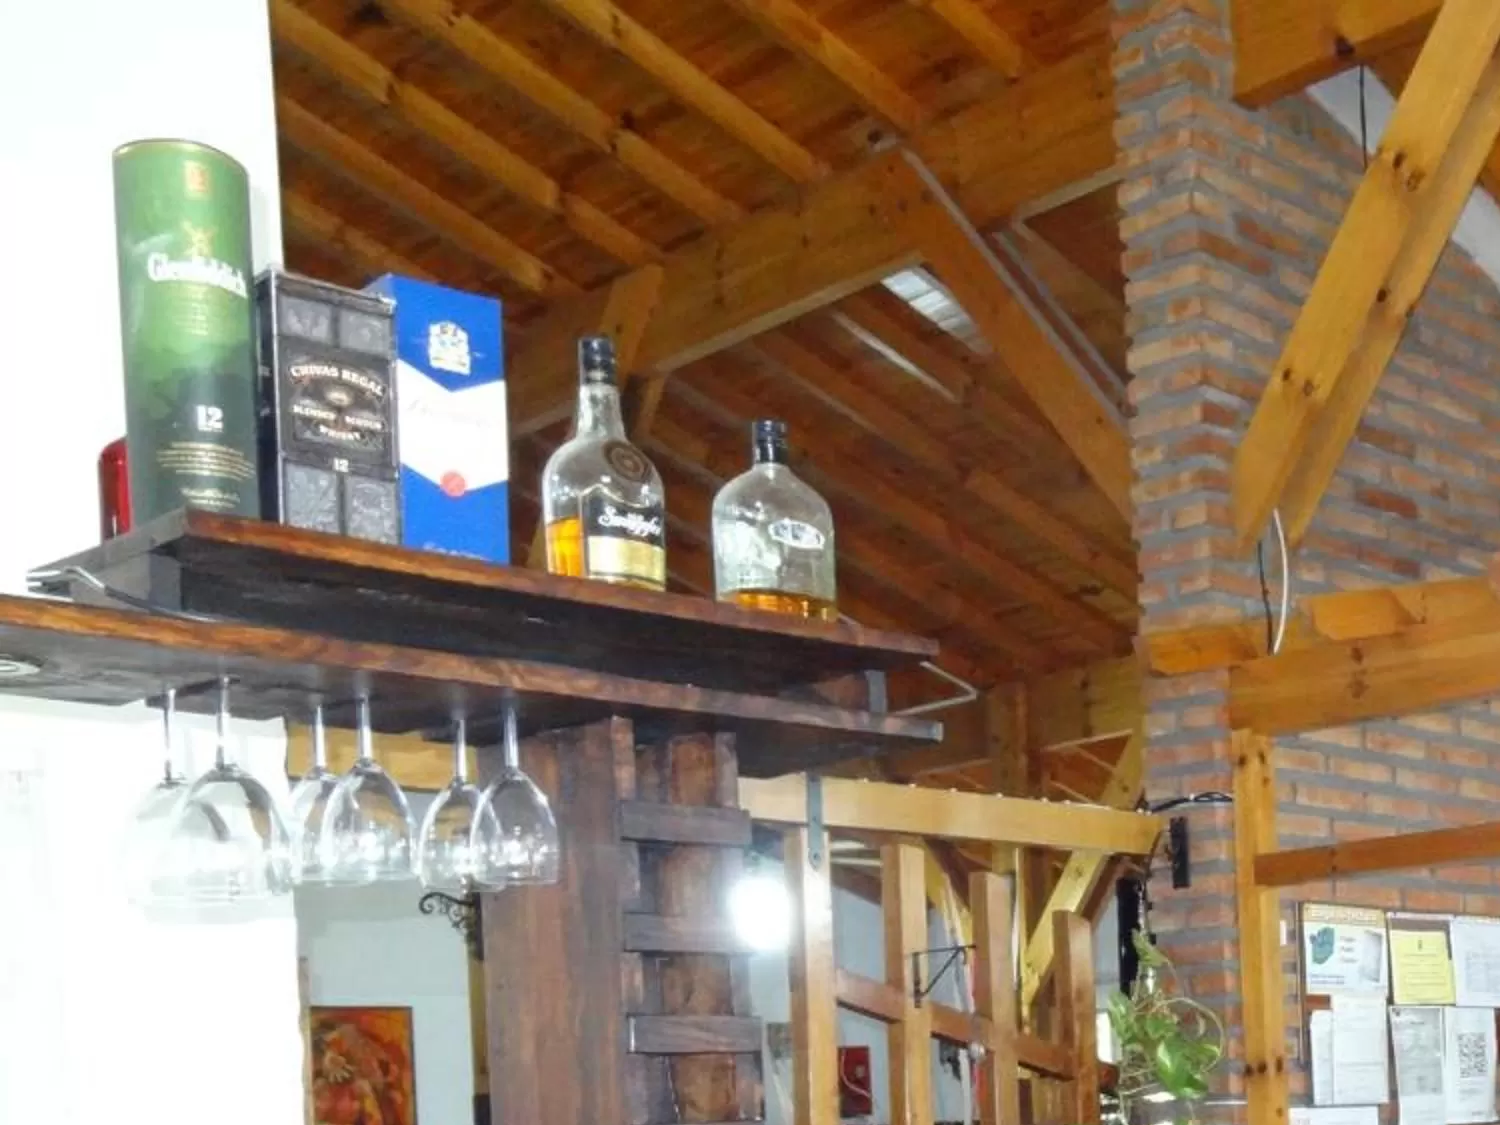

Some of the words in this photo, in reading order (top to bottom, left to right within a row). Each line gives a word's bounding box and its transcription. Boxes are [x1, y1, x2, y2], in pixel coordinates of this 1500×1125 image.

[290, 364, 339, 377] CHIVAS
[341, 368, 383, 397] REGAL
[196, 404, 224, 432] 12
[333, 457, 349, 472] 12
